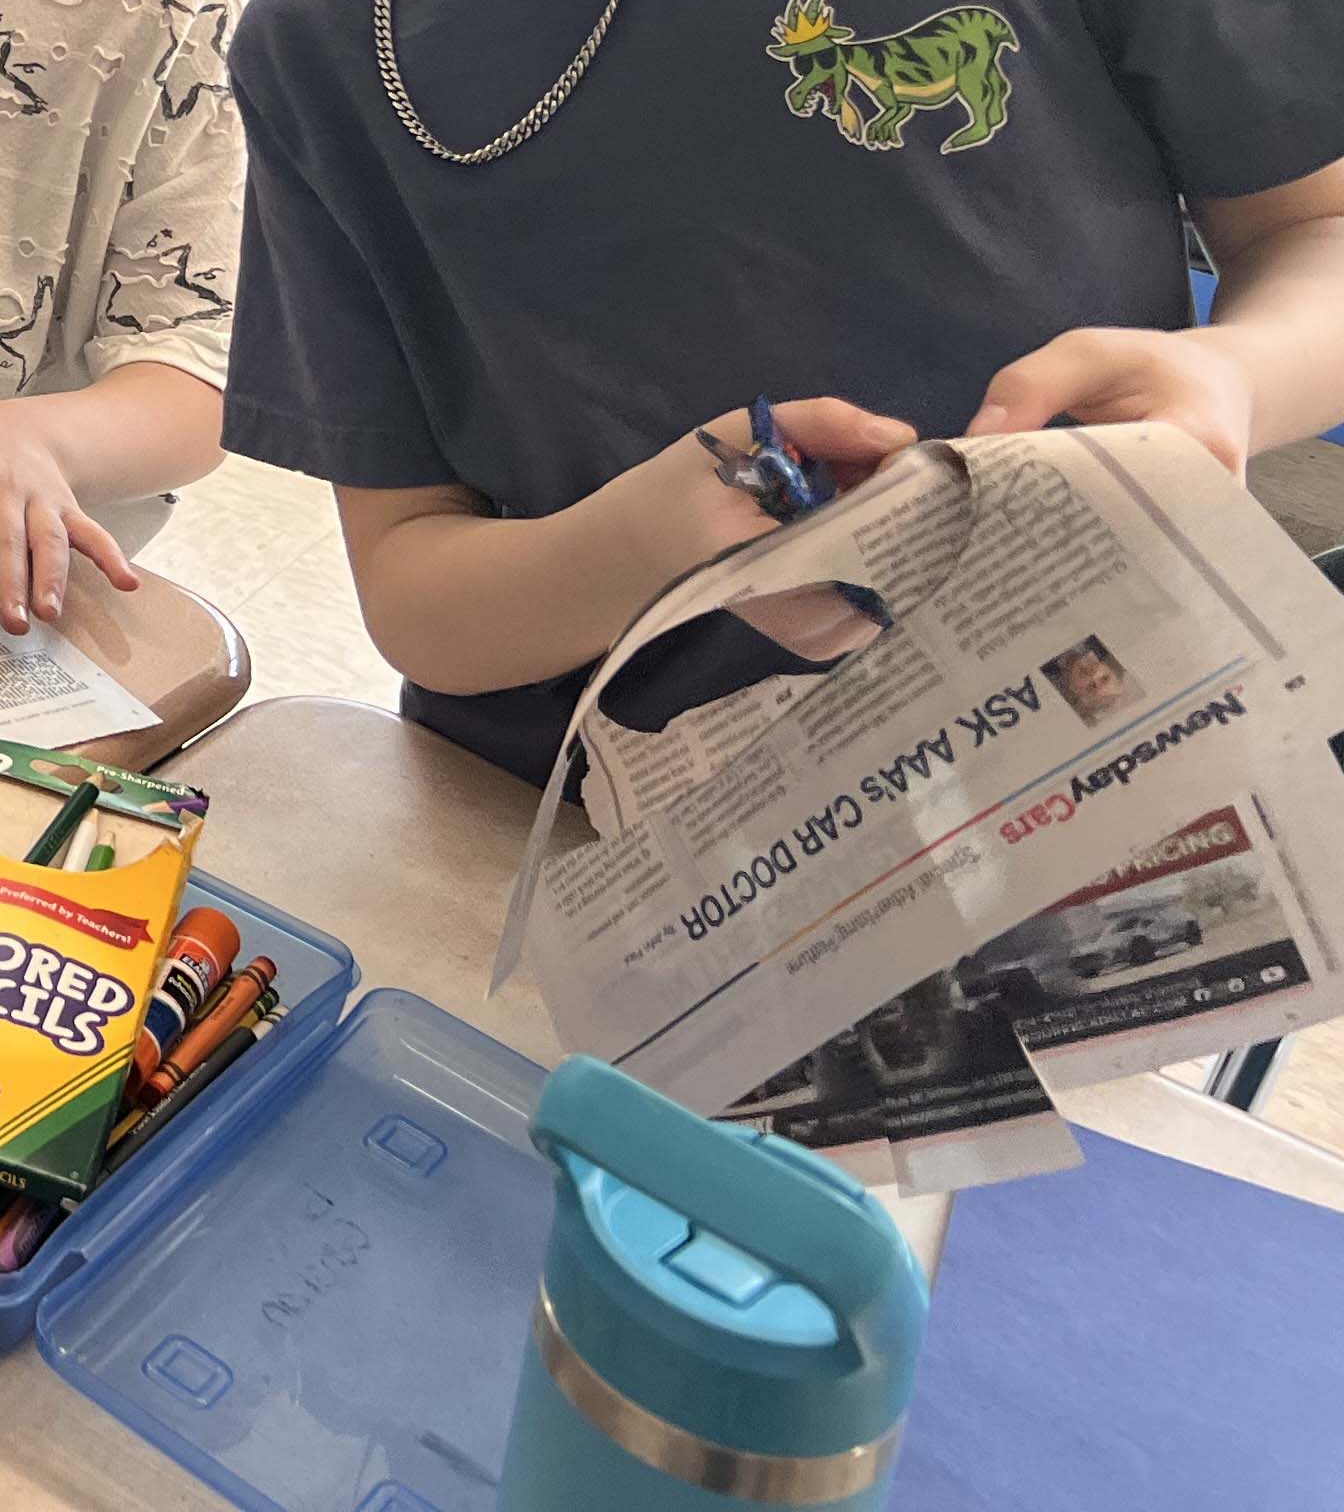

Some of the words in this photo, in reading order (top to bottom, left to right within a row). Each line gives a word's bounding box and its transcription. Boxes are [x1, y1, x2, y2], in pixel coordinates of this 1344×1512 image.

[955, 675, 1043, 748] ASK
[96, 764, 186, 797] Pre-Sharpened
[858, 726, 956, 804] AAA's
[798, 792, 865, 861] CAR
[0, 885, 58, 914] Preferred
[58, 905, 74, 922] by
[75, 913, 134, 946] Teachers!
[679, 845, 799, 942] DOCTOR
